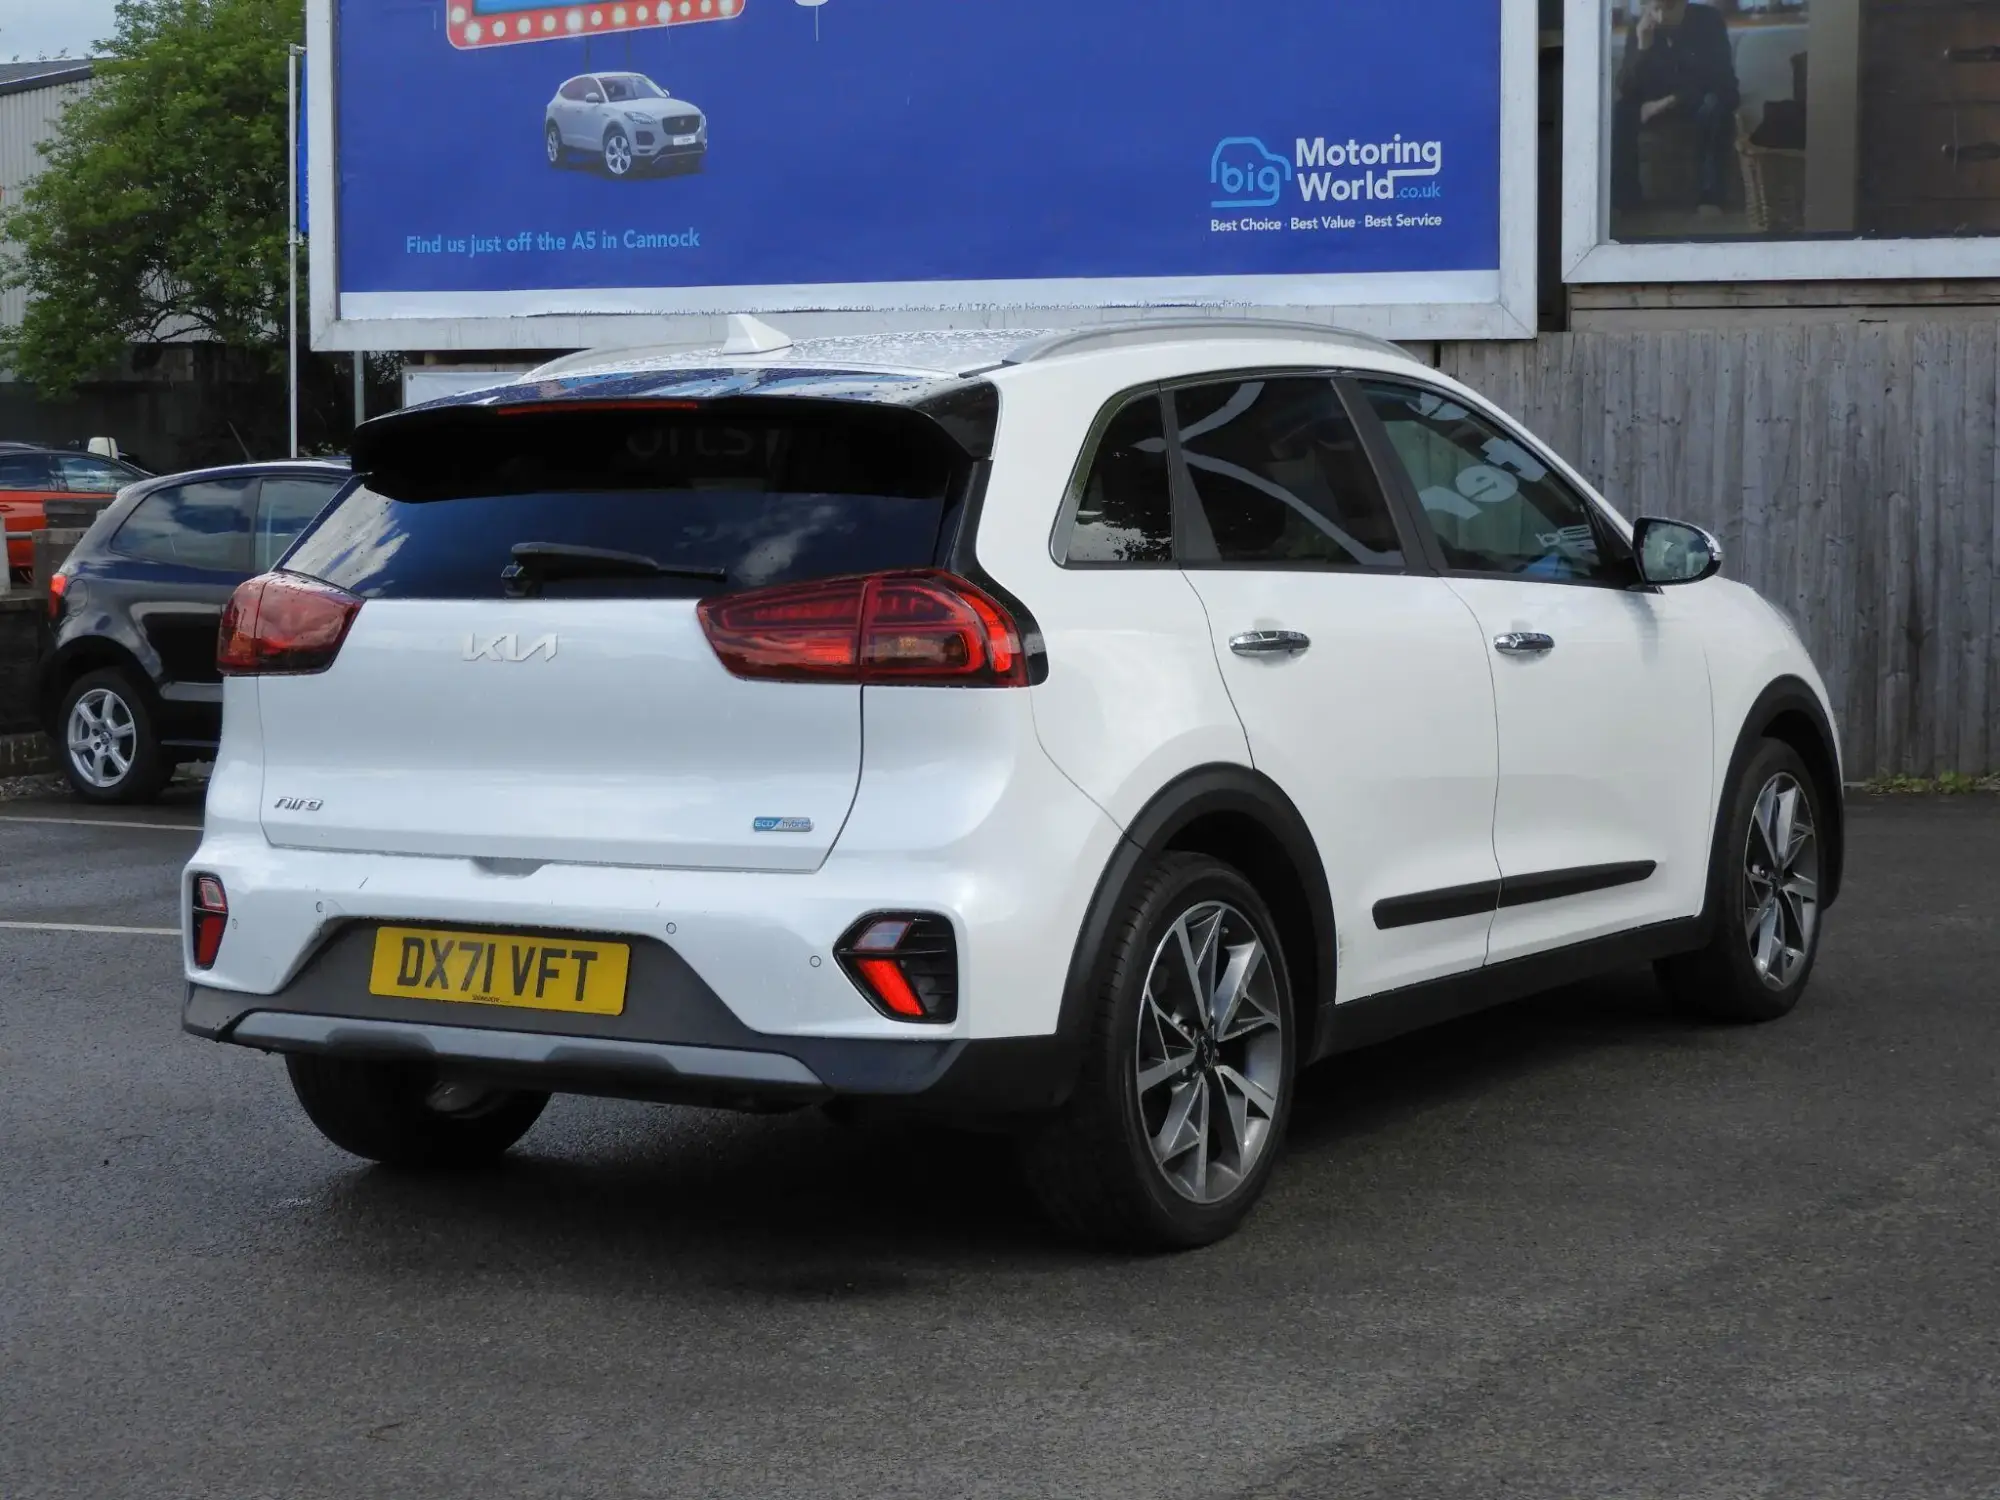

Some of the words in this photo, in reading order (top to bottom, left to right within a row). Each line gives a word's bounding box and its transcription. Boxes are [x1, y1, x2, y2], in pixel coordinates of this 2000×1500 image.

[1296, 133, 1442, 176] Motoring
[1221, 161, 1280, 206] big
[1211, 219, 1237, 232] Best
[1240, 217, 1282, 231] Choice
[1290, 217, 1318, 230] Best
[1321, 215, 1356, 229] Value
[1365, 214, 1392, 228] Best
[1396, 212, 1442, 227] Service
[406, 235, 442, 254] Find
[447, 238, 466, 252] us
[469, 234, 501, 258] just
[507, 232, 532, 251] off
[537, 231, 566, 250] the
[572, 231, 596, 250] A5
[602, 230, 618, 249] in
[623, 227, 701, 249] Cannock
[462, 632, 558, 662] KIA
[396, 937, 496, 993] DX71
[511, 945, 598, 1002] VFT
